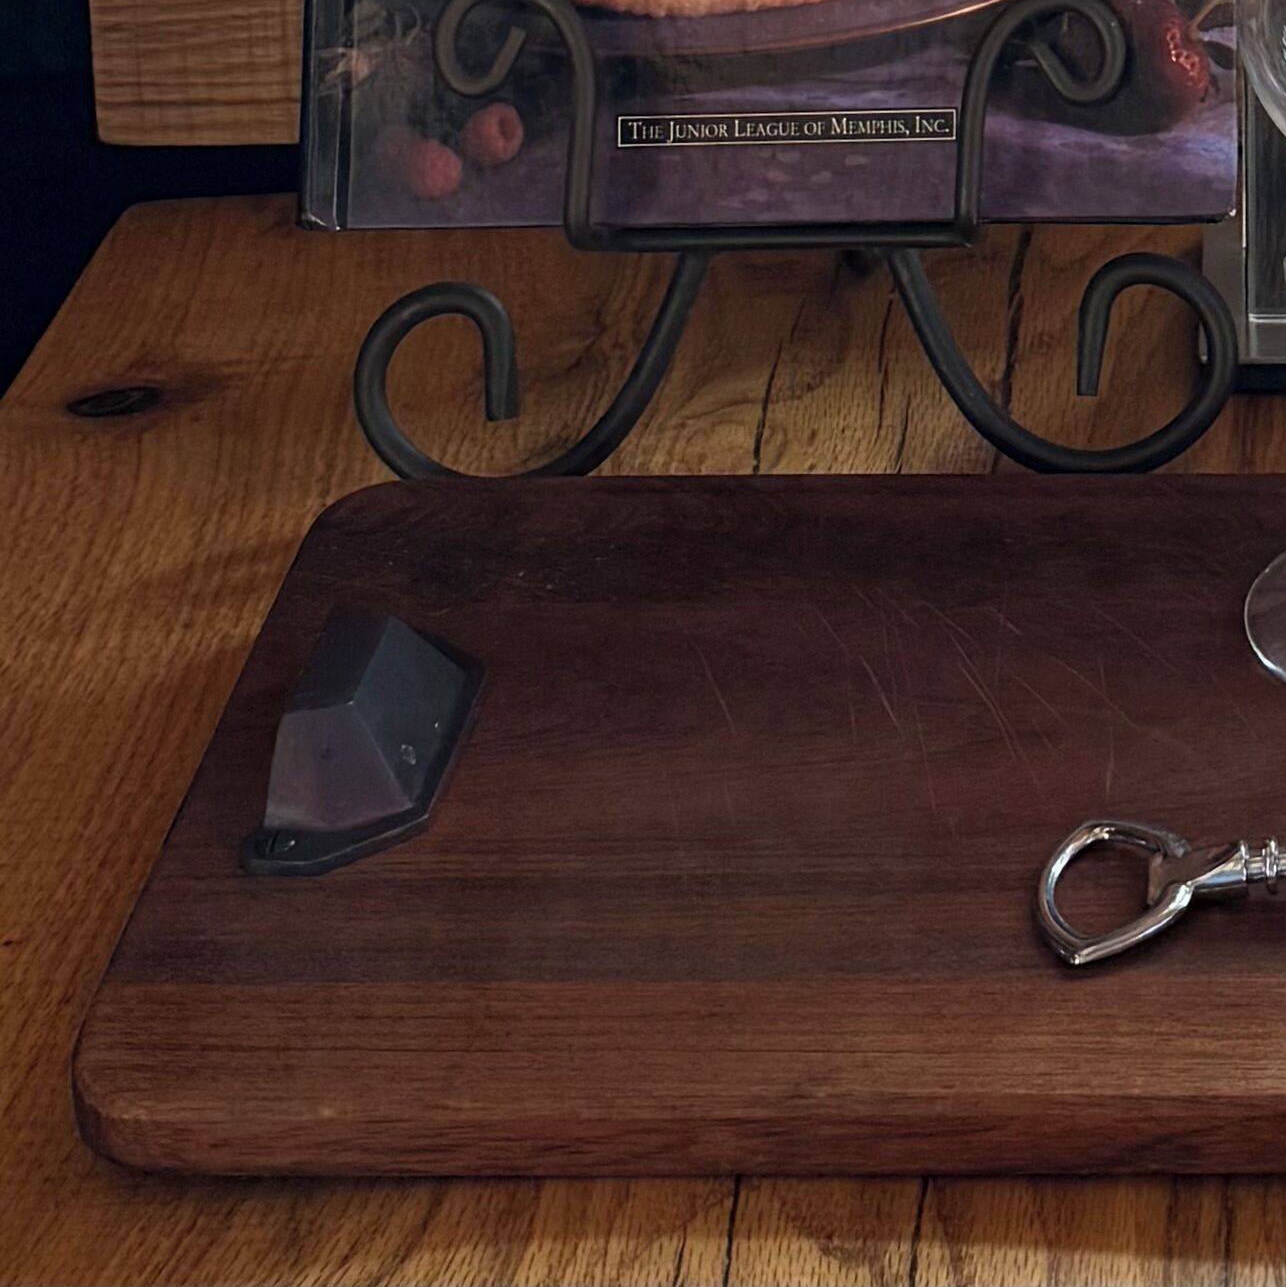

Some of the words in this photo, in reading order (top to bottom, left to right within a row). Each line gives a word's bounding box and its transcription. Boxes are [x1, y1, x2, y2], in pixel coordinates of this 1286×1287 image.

[627, 121, 664, 140] THE
[666, 120, 729, 143] JUNIOR
[734, 119, 800, 137] LEAGUE
[803, 121, 826, 136] OF
[830, 116, 911, 137] MEMPHIS,
[915, 115, 950, 134] INC.
